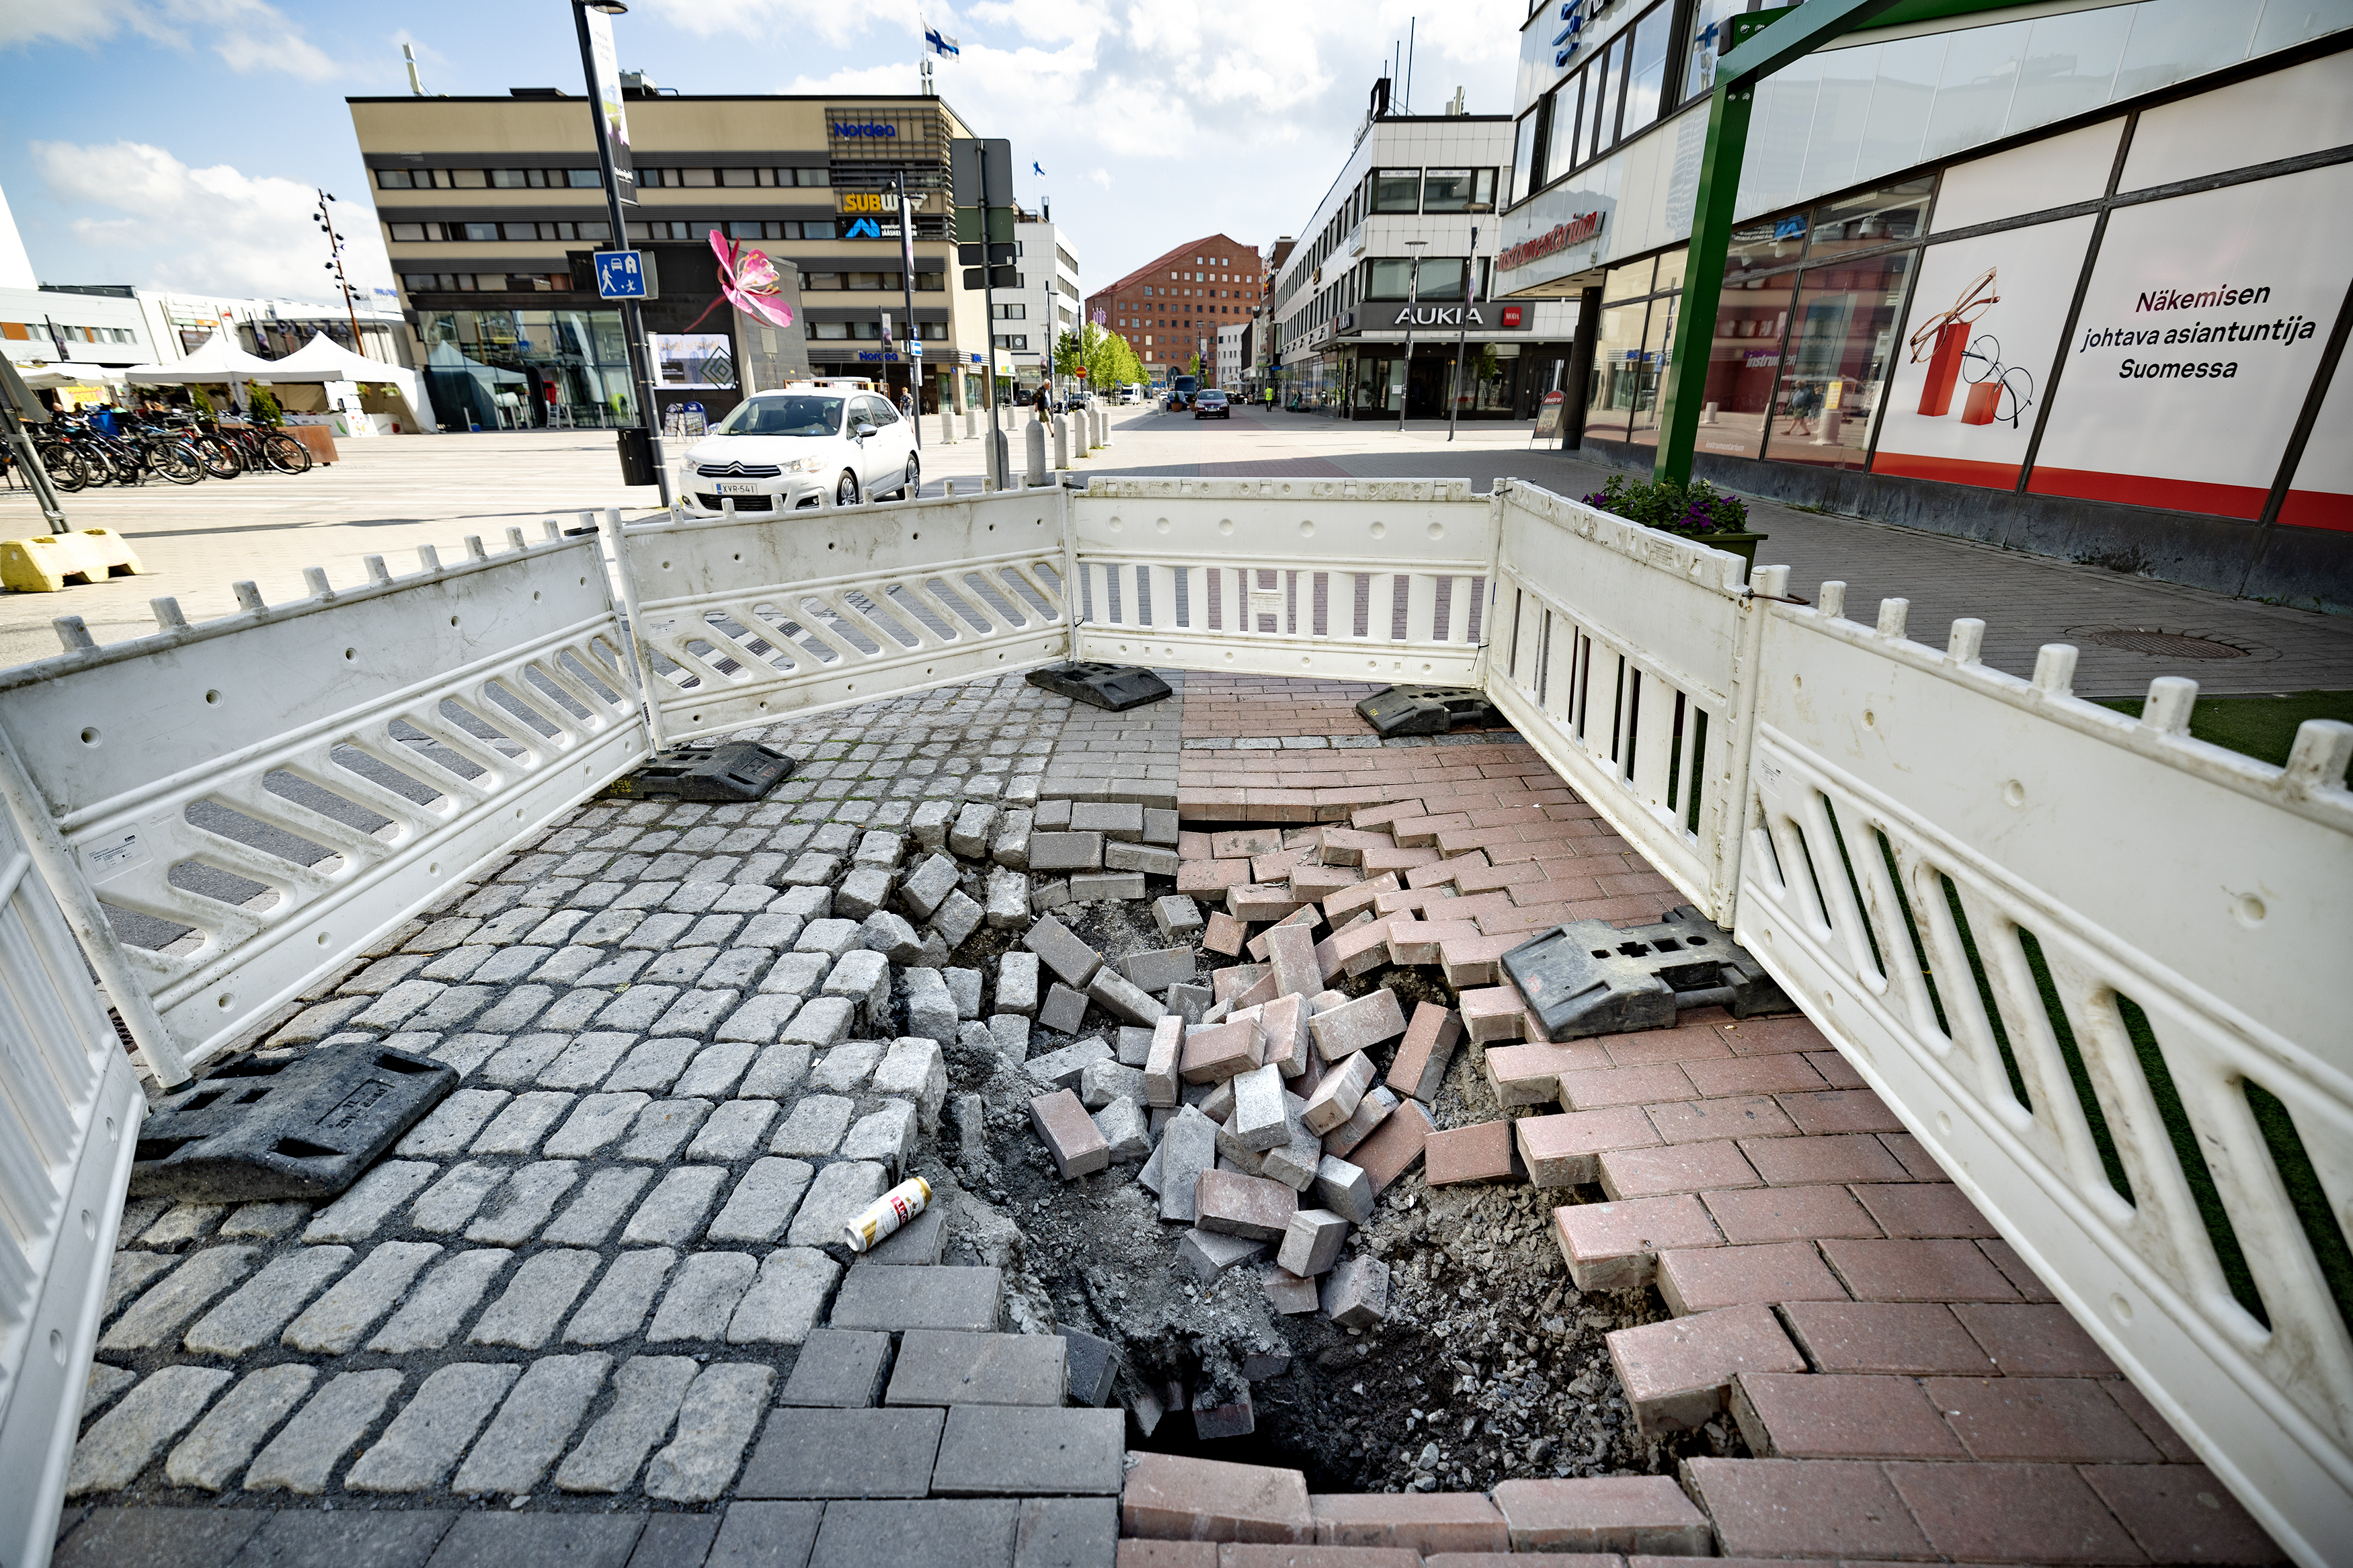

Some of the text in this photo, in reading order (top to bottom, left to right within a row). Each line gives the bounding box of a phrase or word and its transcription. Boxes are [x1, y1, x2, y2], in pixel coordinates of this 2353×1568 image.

[834, 121, 895, 137] Nordea
[843, 193, 928, 212] SUBWY
[1497, 210, 1598, 272] instrumentarium
[2135, 283, 2271, 313] Näkemisen
[1394, 306, 1484, 325] AUKIA
[1505, 311, 1519, 321] MODA
[276, 319, 350, 338] PLAZA
[2079, 315, 2317, 353] johtava asiantuntija
[2119, 358, 2239, 379] Suomessa
[1705, 440, 1745, 452] instrumentarium
[722, 485, 754, 493] XVR-541
